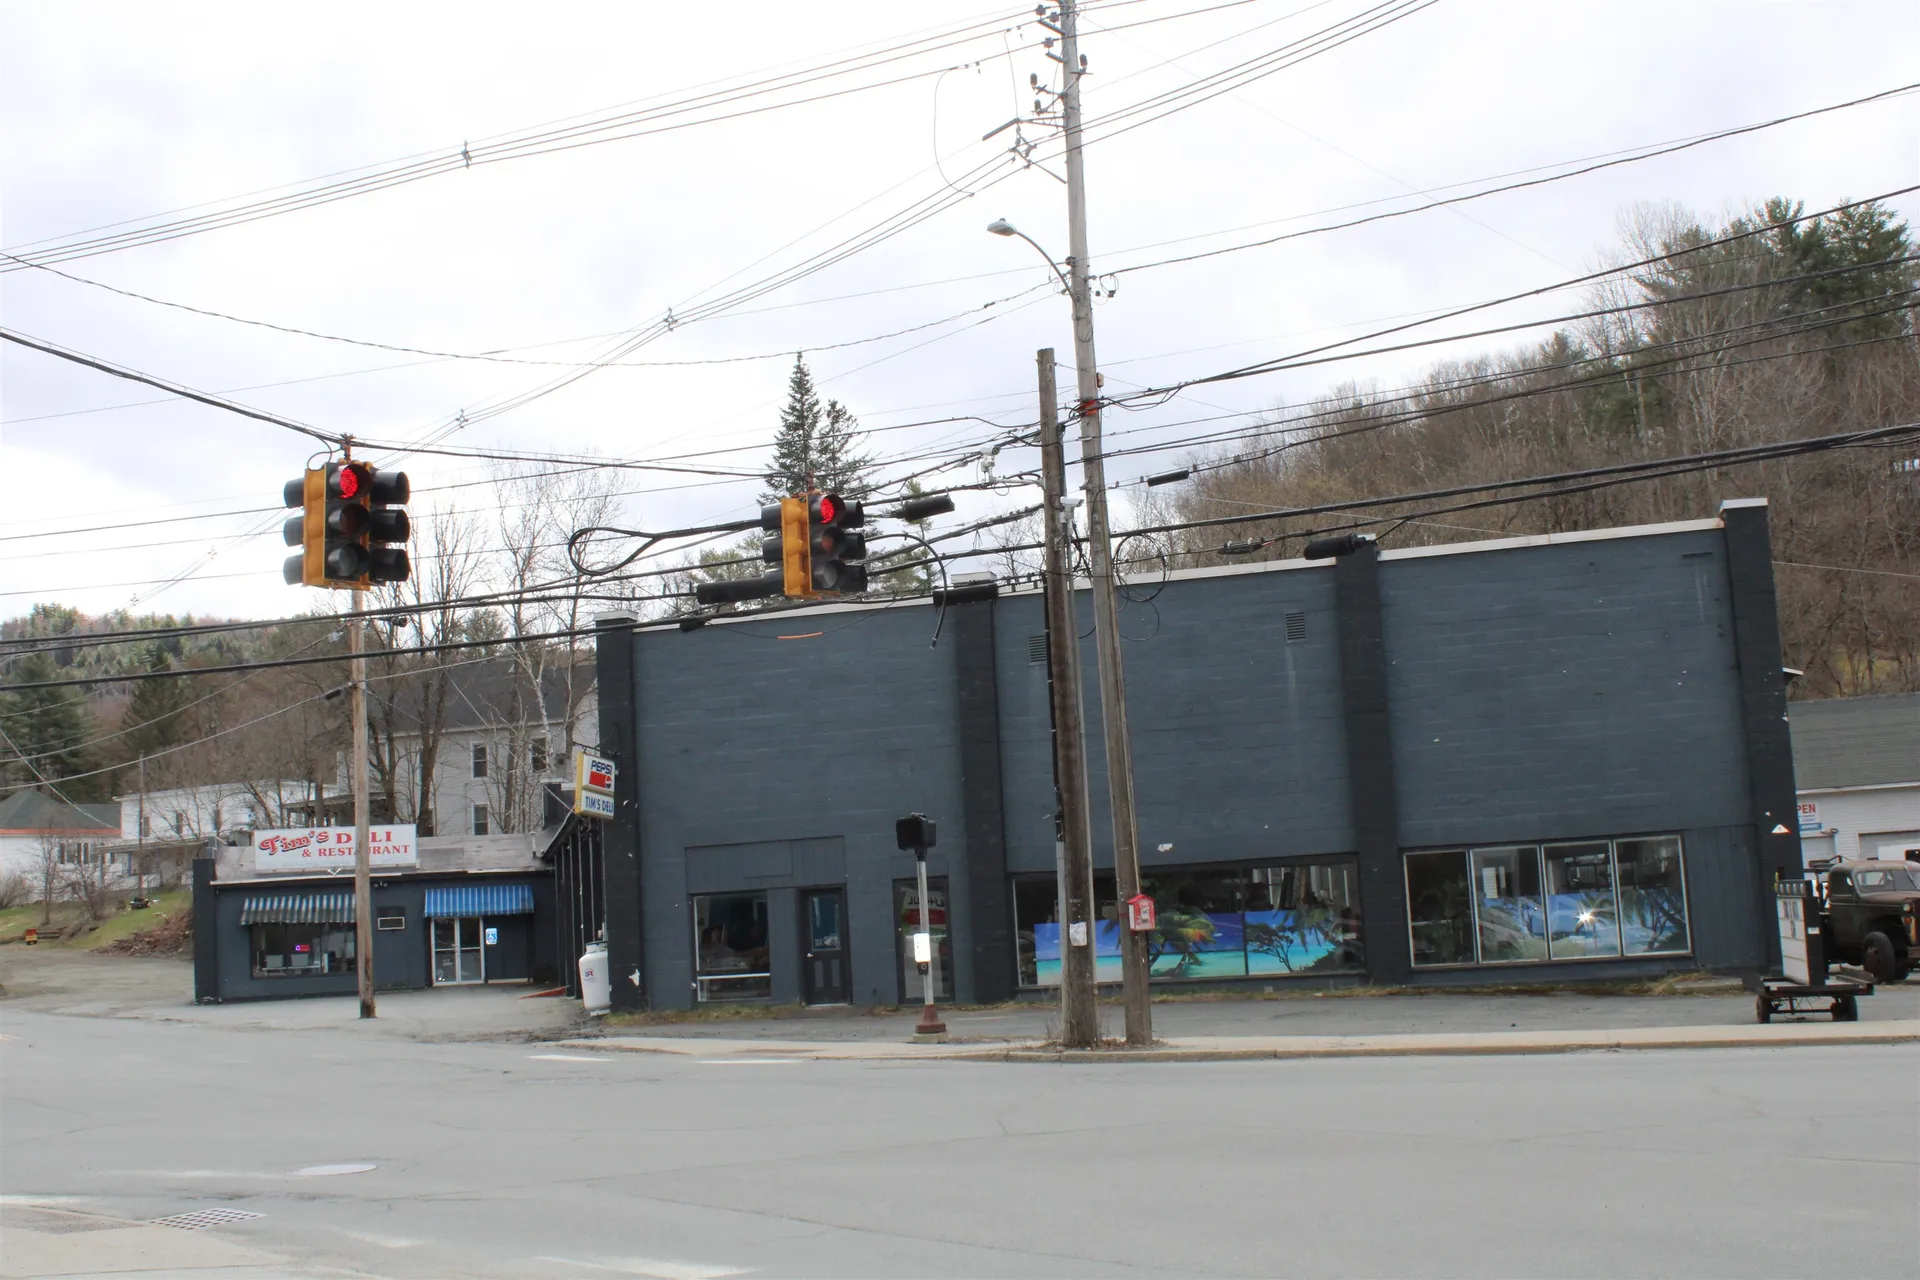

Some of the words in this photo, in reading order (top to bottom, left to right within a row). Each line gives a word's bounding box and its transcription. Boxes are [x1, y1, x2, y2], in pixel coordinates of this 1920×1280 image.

[591, 760, 613, 775] PEPSI
[585, 796, 601, 810] TIM'S
[601, 800, 614, 813] DELI
[1797, 803, 1816, 814] PEN
[258, 830, 330, 855] Tim's
[335, 831, 393, 844] DLI
[301, 849, 312, 857] &
